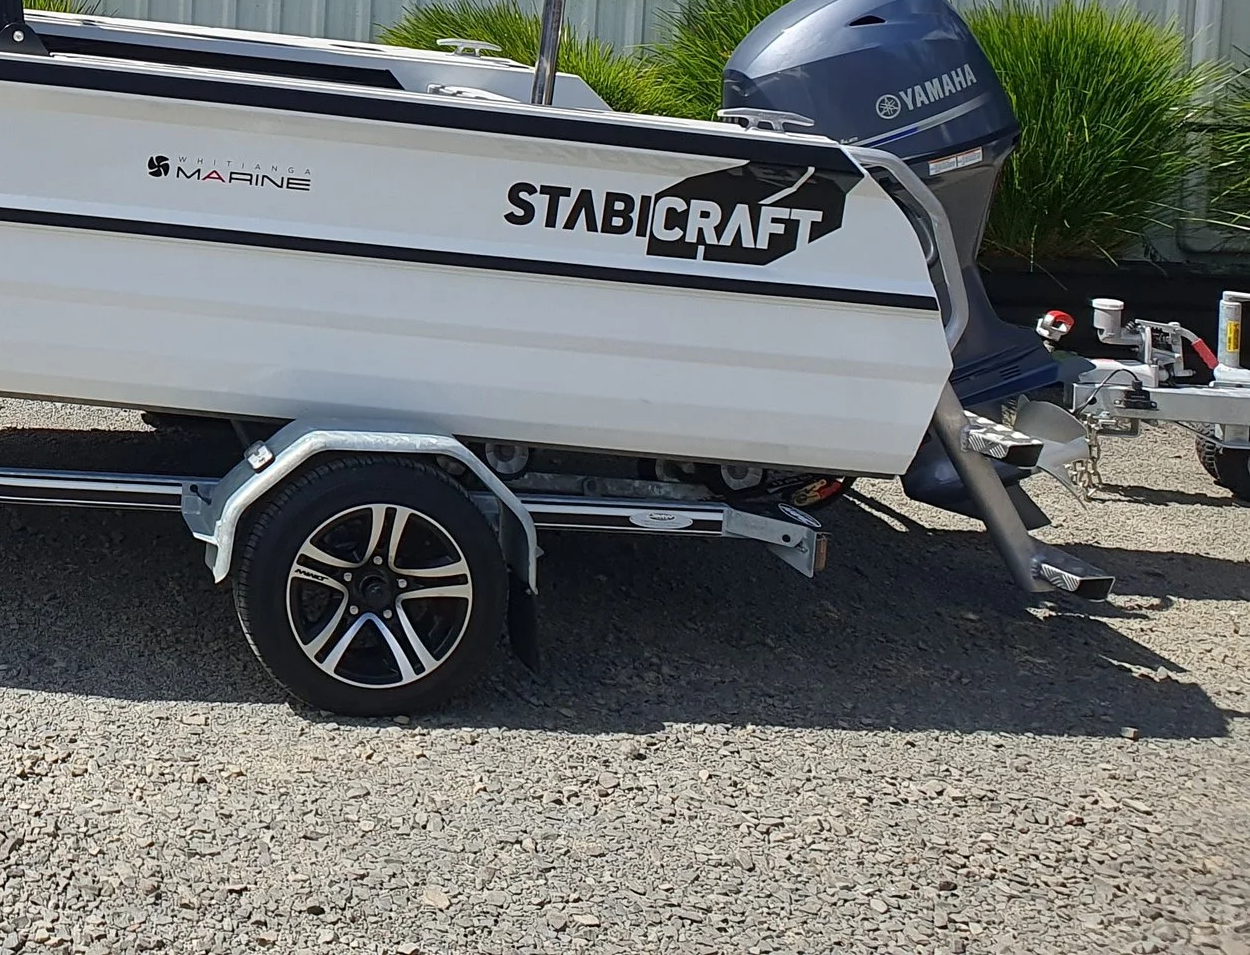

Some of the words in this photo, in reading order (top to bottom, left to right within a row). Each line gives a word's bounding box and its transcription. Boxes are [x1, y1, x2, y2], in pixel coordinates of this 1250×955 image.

[899, 63, 978, 111] YAMAHA
[176, 166, 311, 192] MARINE
[178, 156, 311, 176] WHITIANGA
[503, 181, 823, 251] STABICRAFT
